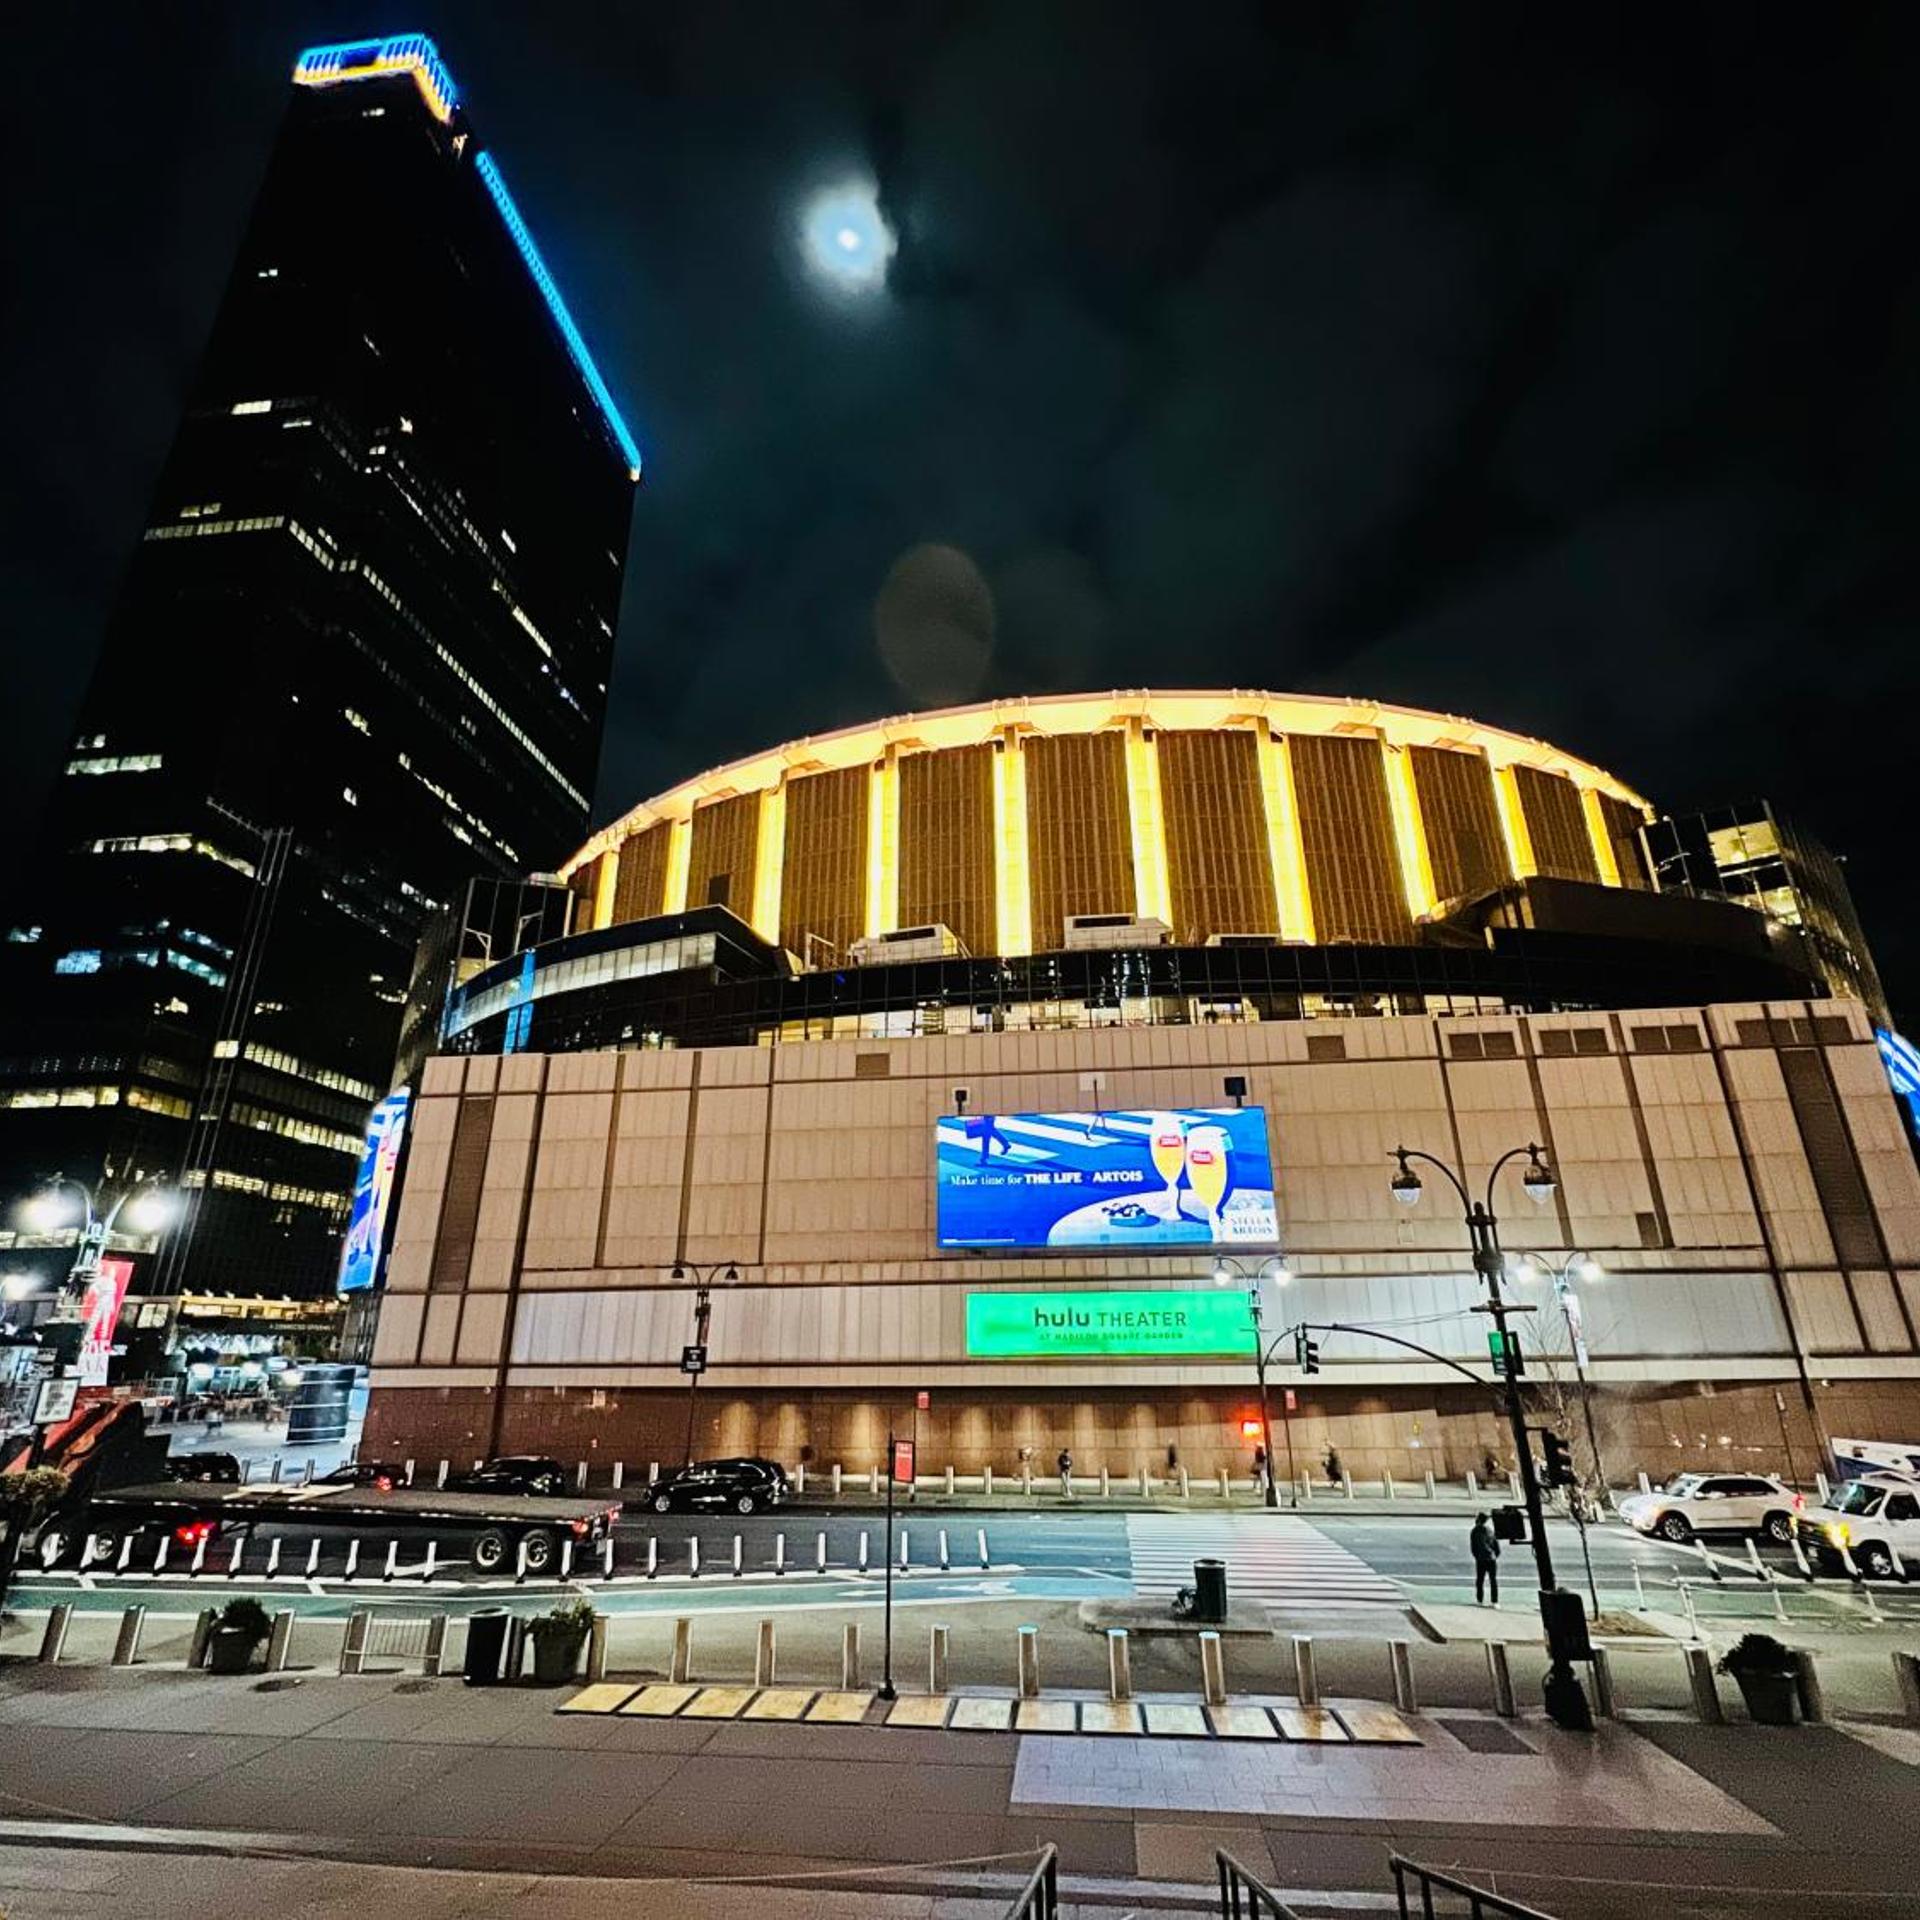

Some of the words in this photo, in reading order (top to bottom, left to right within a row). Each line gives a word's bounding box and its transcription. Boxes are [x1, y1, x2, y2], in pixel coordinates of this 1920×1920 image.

[951, 1174, 978, 1186] Make
[981, 1173, 1005, 1185] time
[1007, 1173, 1023, 1185] for
[1024, 1173, 1051, 1185] THE
[1053, 1171, 1083, 1184] LIFE
[1093, 1170, 1144, 1183] ARTOIS
[1034, 1306, 1090, 1328] hulu
[1097, 1311, 1187, 1327] THEATER
